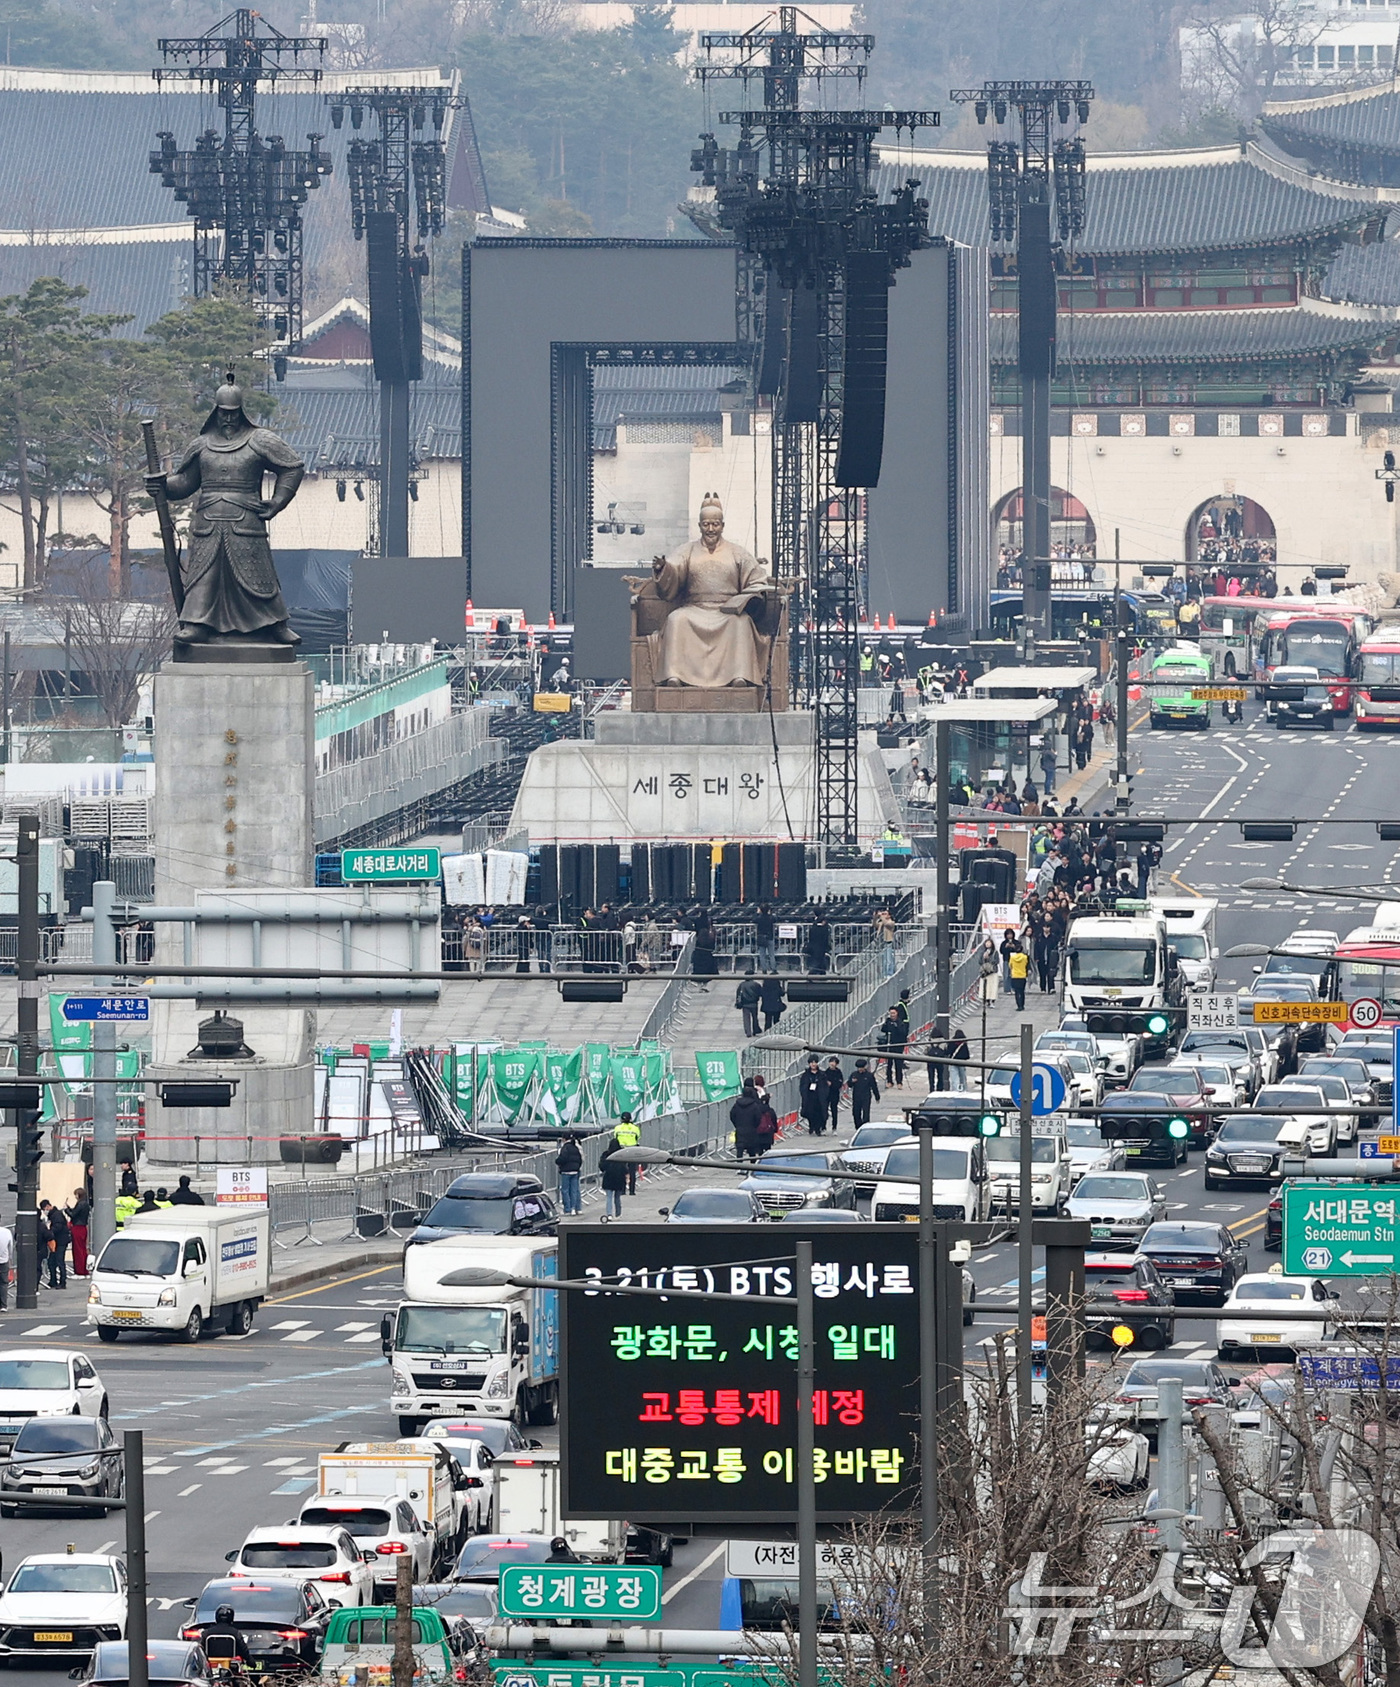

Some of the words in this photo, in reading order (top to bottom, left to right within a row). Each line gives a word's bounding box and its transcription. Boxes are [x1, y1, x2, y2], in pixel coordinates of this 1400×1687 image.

[633, 771, 765, 800] 세종대왕
[351, 854, 429, 873] 세종대로사거리
[101, 999, 146, 1010] 새문안로
[1260, 1006, 1342, 1020] 신호과속단속장비
[96, 1011, 147, 1019] Saemunan-ro
[1190, 1013, 1236, 1028] 직좌신호
[1356, 1006, 1377, 1022] 50
[505, 1063, 525, 1076] BTS
[232, 1171, 251, 1182] BTS
[1303, 1199, 1395, 1225] 서대문역
[1304, 1225, 1371, 1242] Seodaemun
[1374, 1226, 1395, 1242] Stn
[1308, 1252, 1327, 1265] 21
[730, 1266, 793, 1297] BTS
[810, 1262, 915, 1299] 행사로
[610, 1324, 729, 1363] 광화문,
[828, 1324, 897, 1361] 일대
[638, 1389, 781, 1427] 교통통제
[605, 1447, 748, 1485] 대중교통
[754, 1546, 800, 1566] (자전
[516, 1574, 644, 1609] 청계광장
